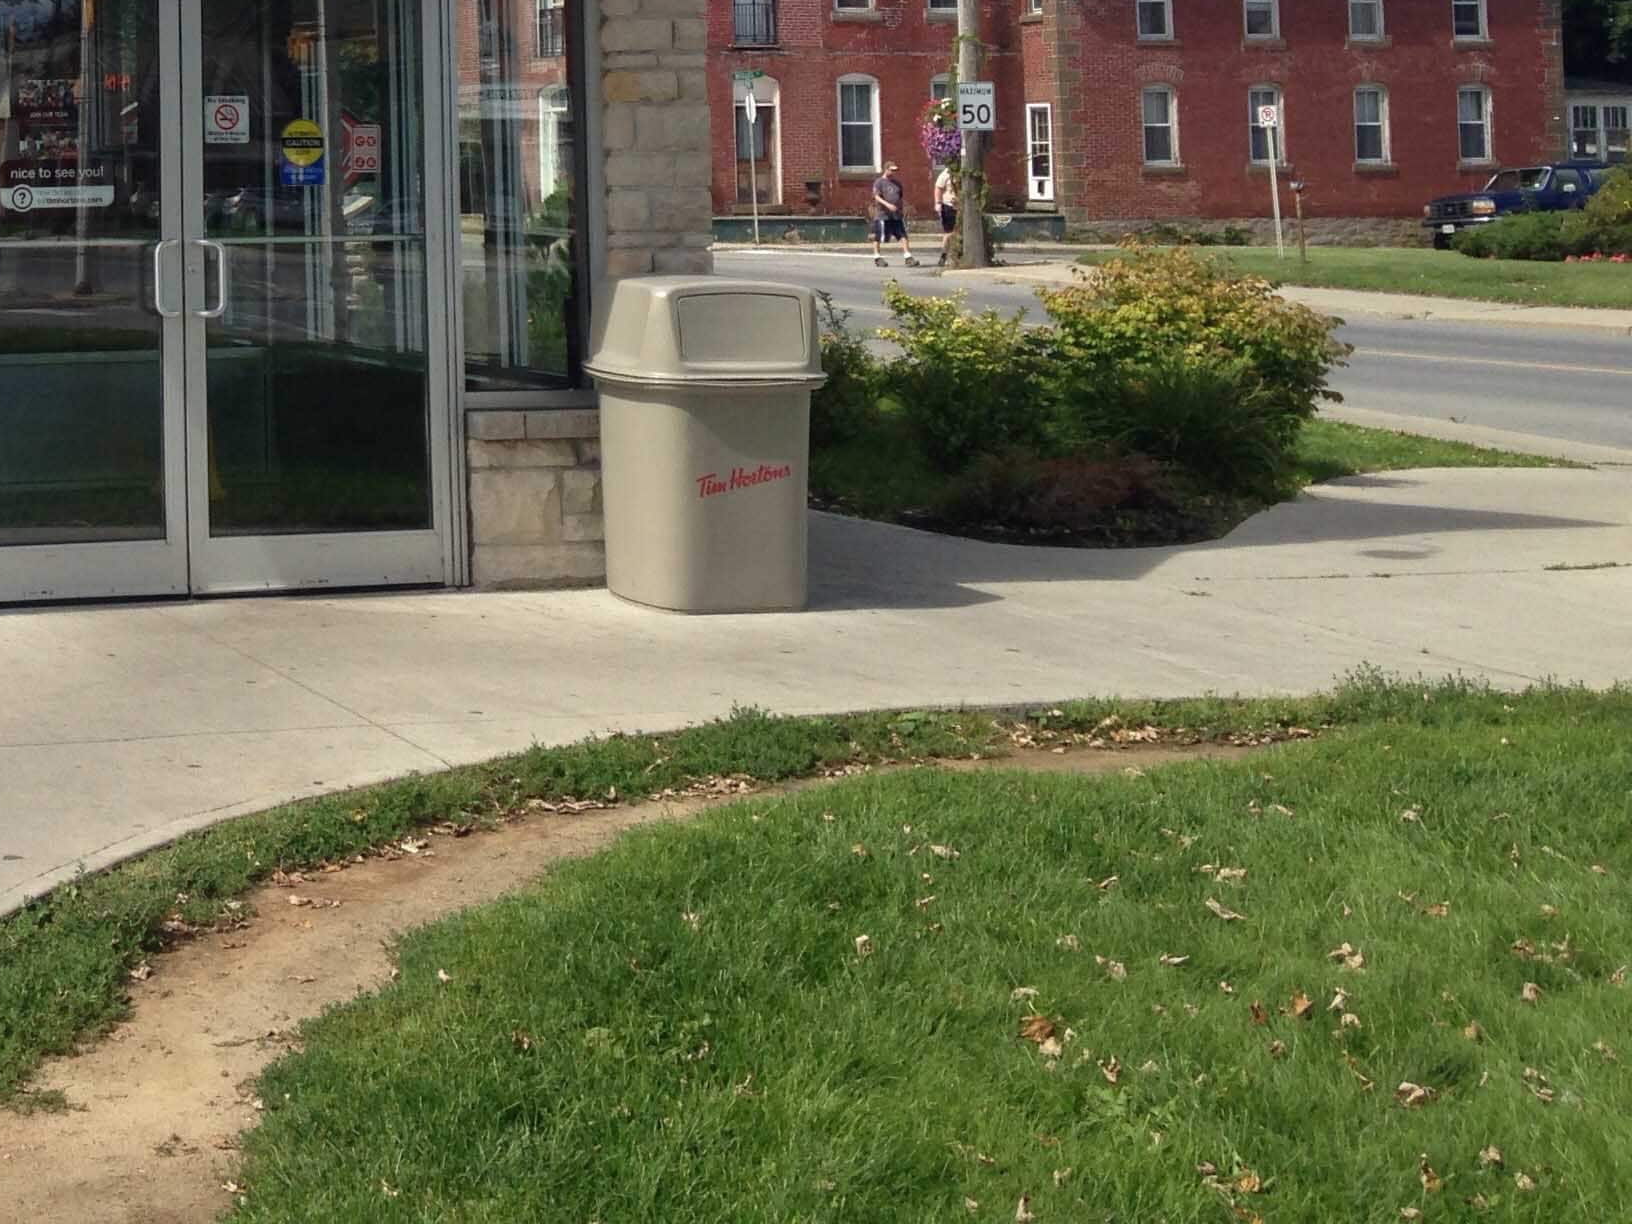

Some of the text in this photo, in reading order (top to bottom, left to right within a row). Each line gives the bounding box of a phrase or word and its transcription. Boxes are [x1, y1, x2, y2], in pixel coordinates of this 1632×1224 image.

[960, 87, 992, 95] MAXIMUM
[962, 104, 991, 124] 50
[10, 165, 104, 180] nice to see you!
[696, 464, 791, 498] Tim Hortons
